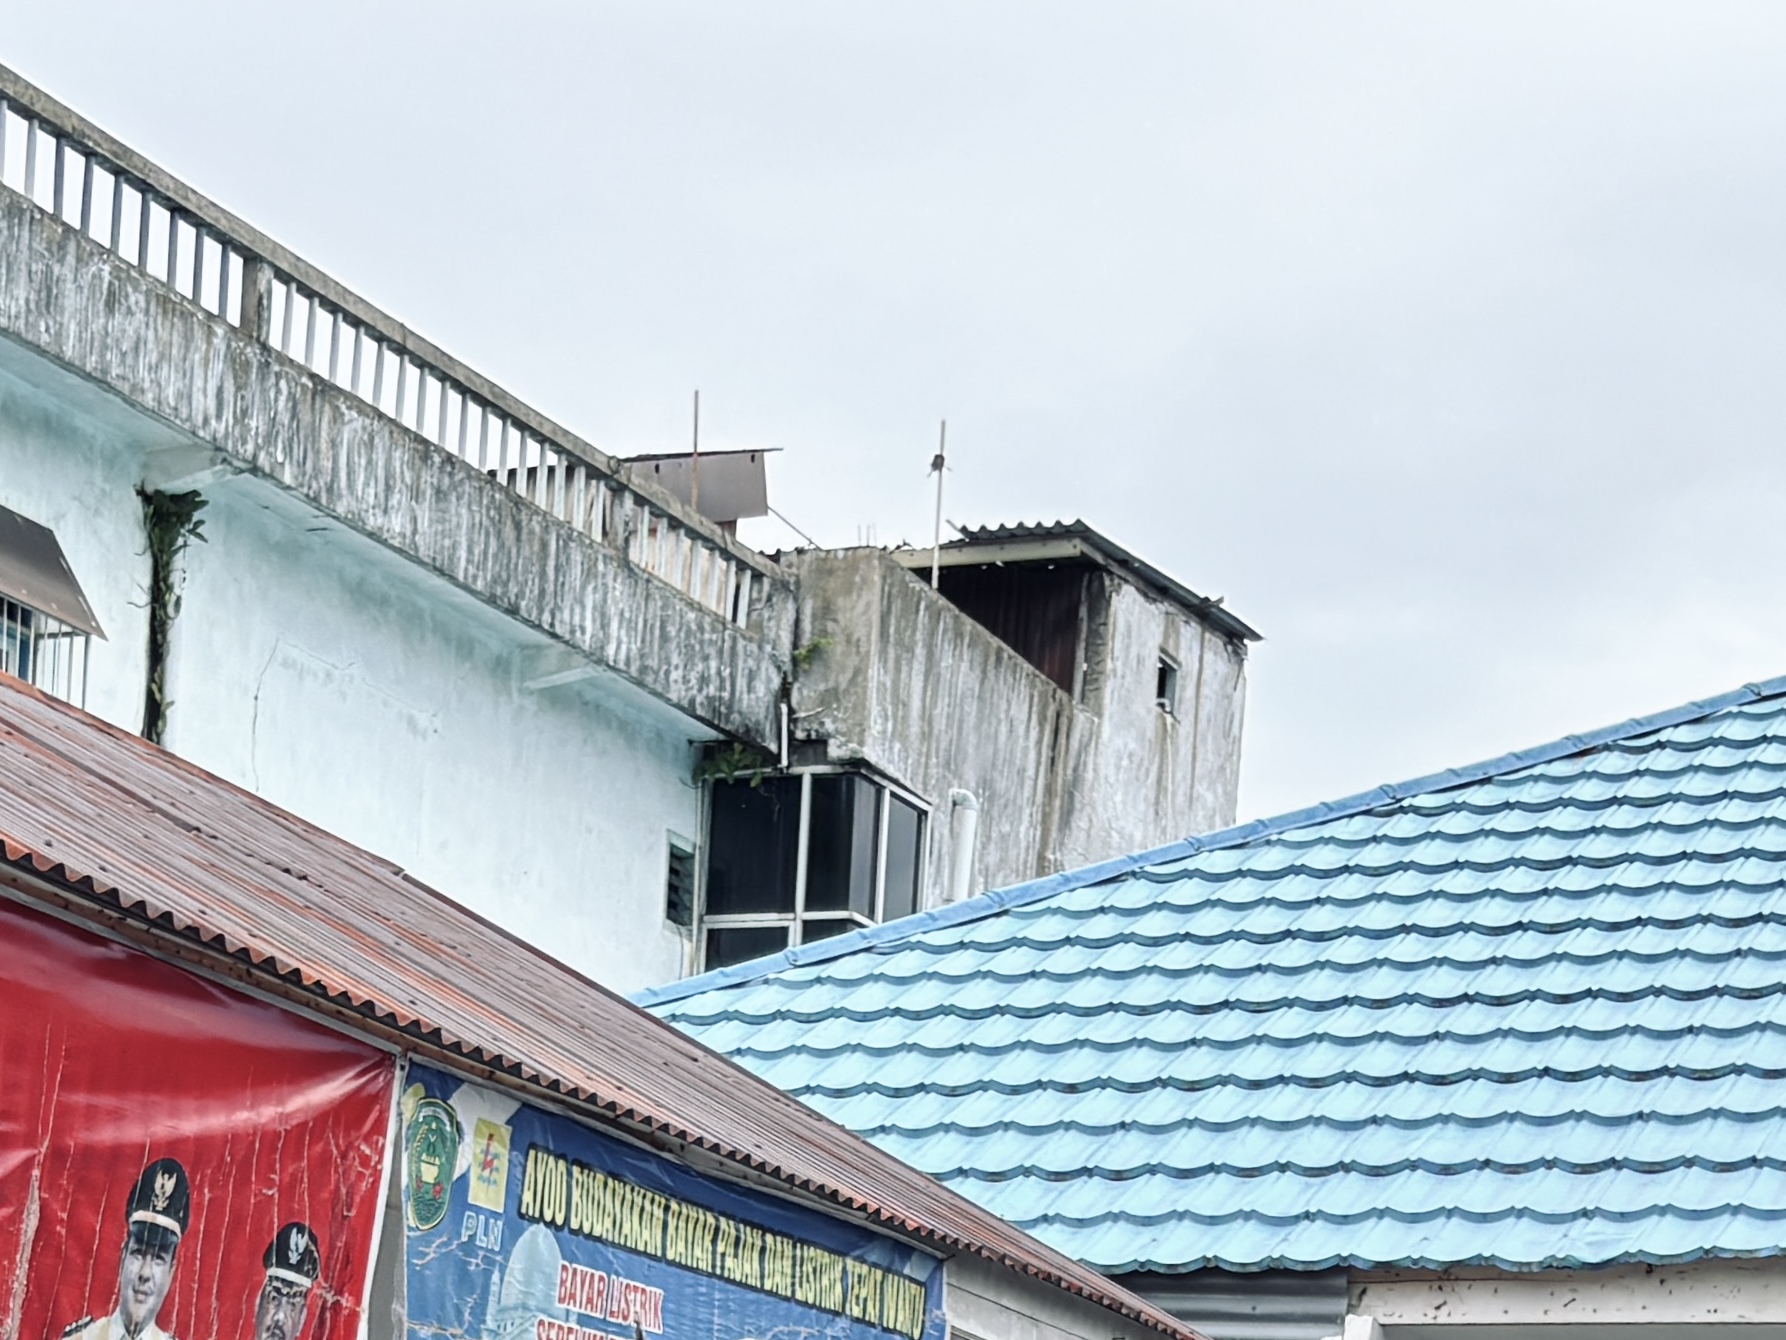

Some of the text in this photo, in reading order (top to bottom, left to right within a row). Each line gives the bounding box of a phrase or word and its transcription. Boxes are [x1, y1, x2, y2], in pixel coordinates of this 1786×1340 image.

[463, 1212, 502, 1251] PLN
[521, 1150, 567, 1226] AYOO
[570, 1164, 666, 1257] BUDAYAKAN
[666, 1202, 715, 1272] BAYAR
[717, 1216, 762, 1288] PAJAK
[763, 1232, 793, 1298] DAN
[795, 1242, 843, 1312] LISTRIK
[845, 1257, 883, 1324] TEPAT
[558, 1264, 661, 1331] BAYAR LISTRIK
